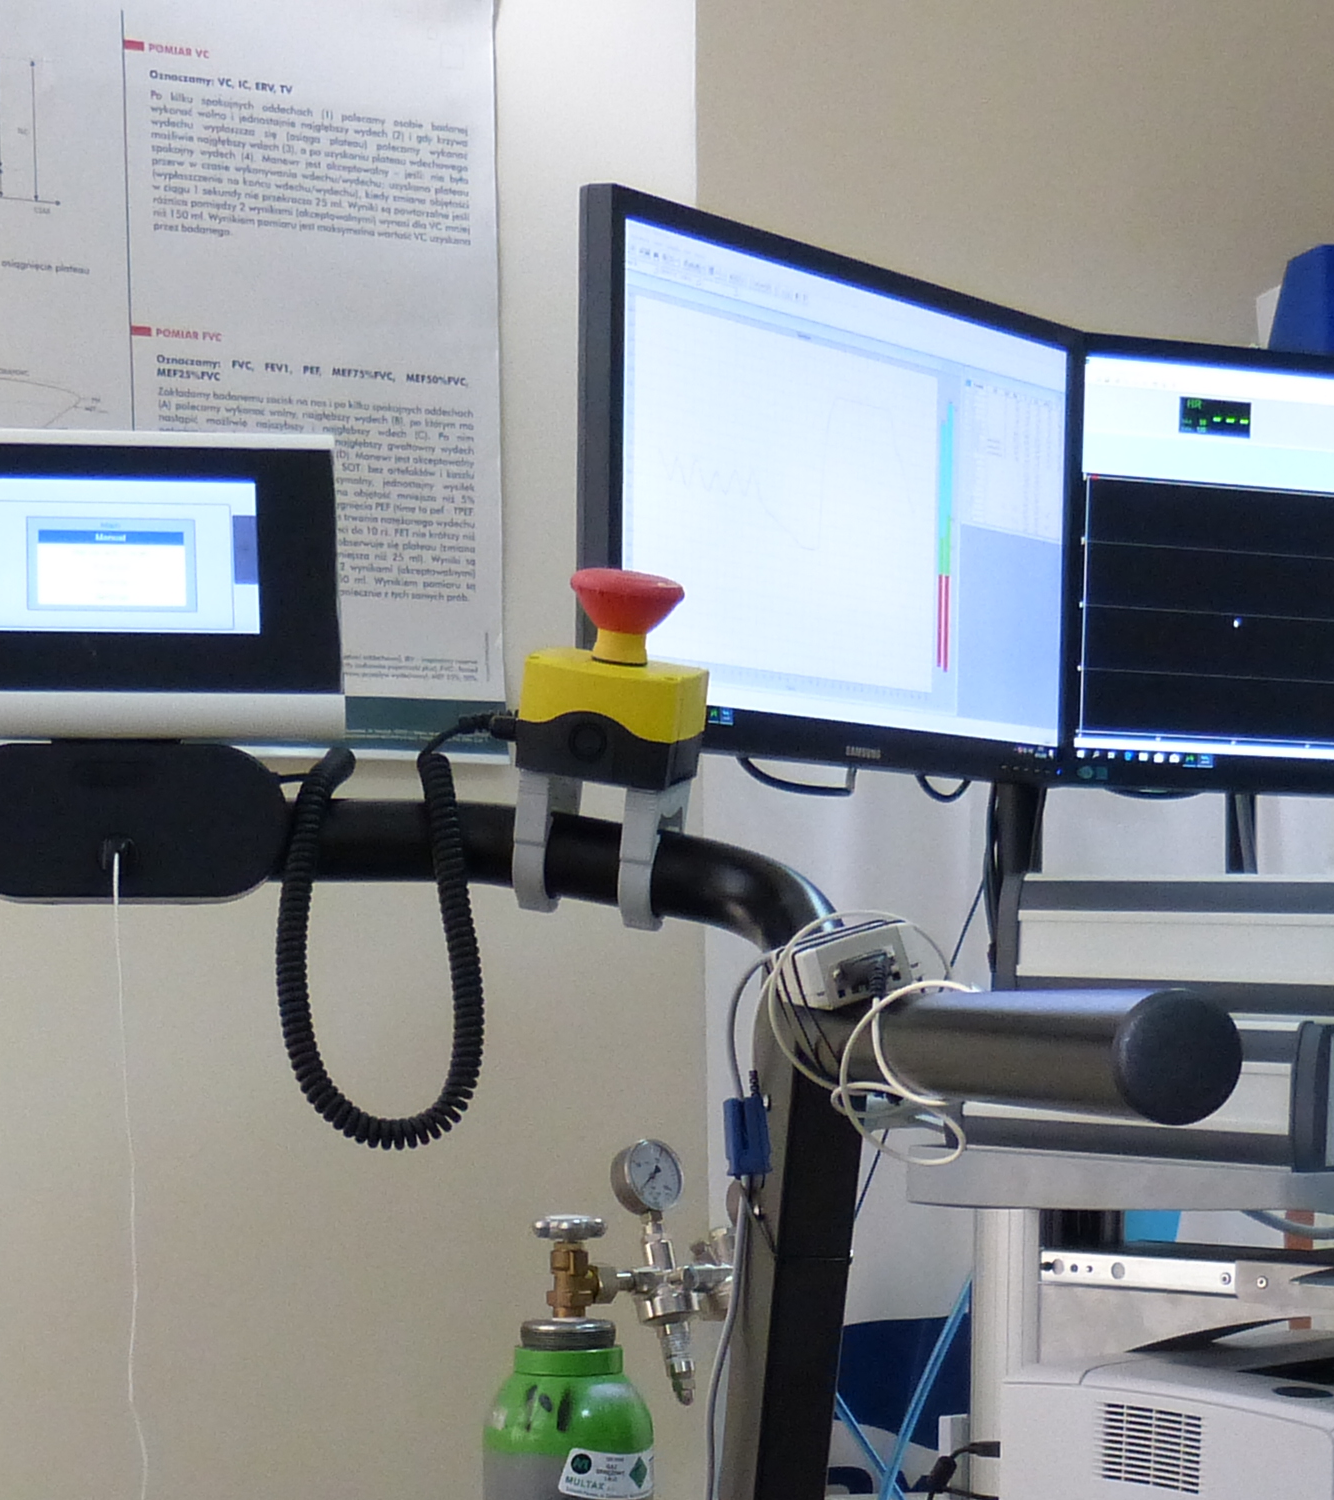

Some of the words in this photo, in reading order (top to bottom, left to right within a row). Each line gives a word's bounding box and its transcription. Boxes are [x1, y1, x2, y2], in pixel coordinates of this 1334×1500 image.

[148, 43, 192, 56] POMIAR
[195, 49, 209, 59] VC
[280, 84, 292, 94] TV
[156, 328, 198, 340] POMIAR
[202, 331, 222, 342] FVC
[95, 533, 126, 542] Manual
